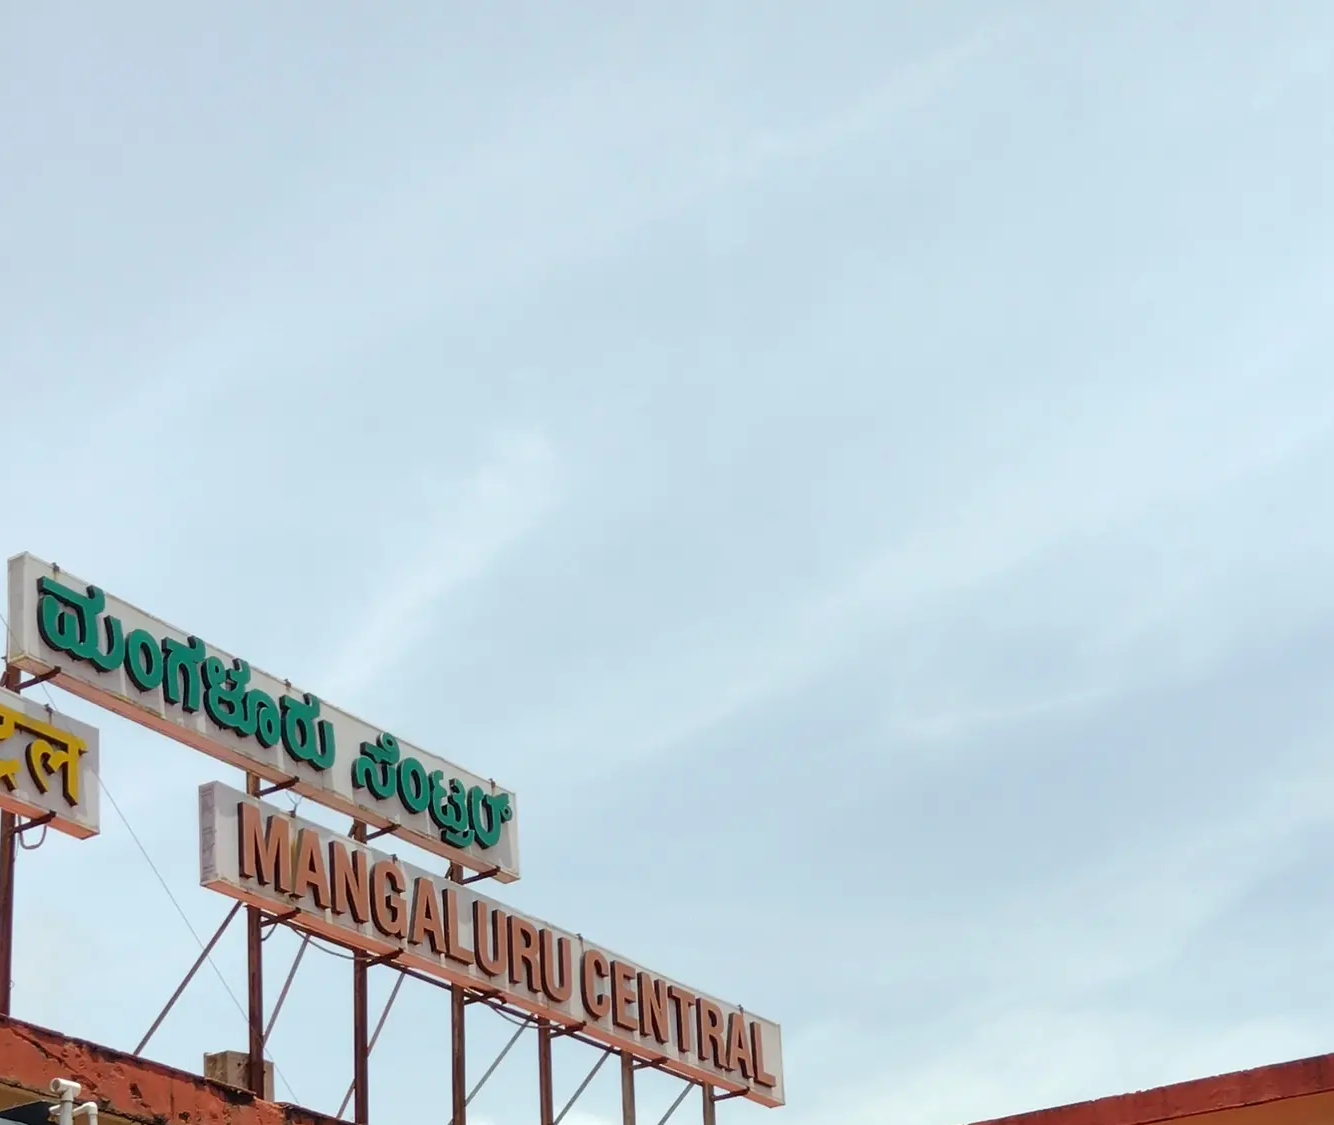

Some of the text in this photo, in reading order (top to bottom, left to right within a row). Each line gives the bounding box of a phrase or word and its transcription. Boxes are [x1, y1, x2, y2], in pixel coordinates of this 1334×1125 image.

[36, 575, 513, 850] ಮಂಗಳೂರು ಸೆಂಟ್ರಲ್
[238, 800, 777, 1089] MANGALURU CENTRAL
